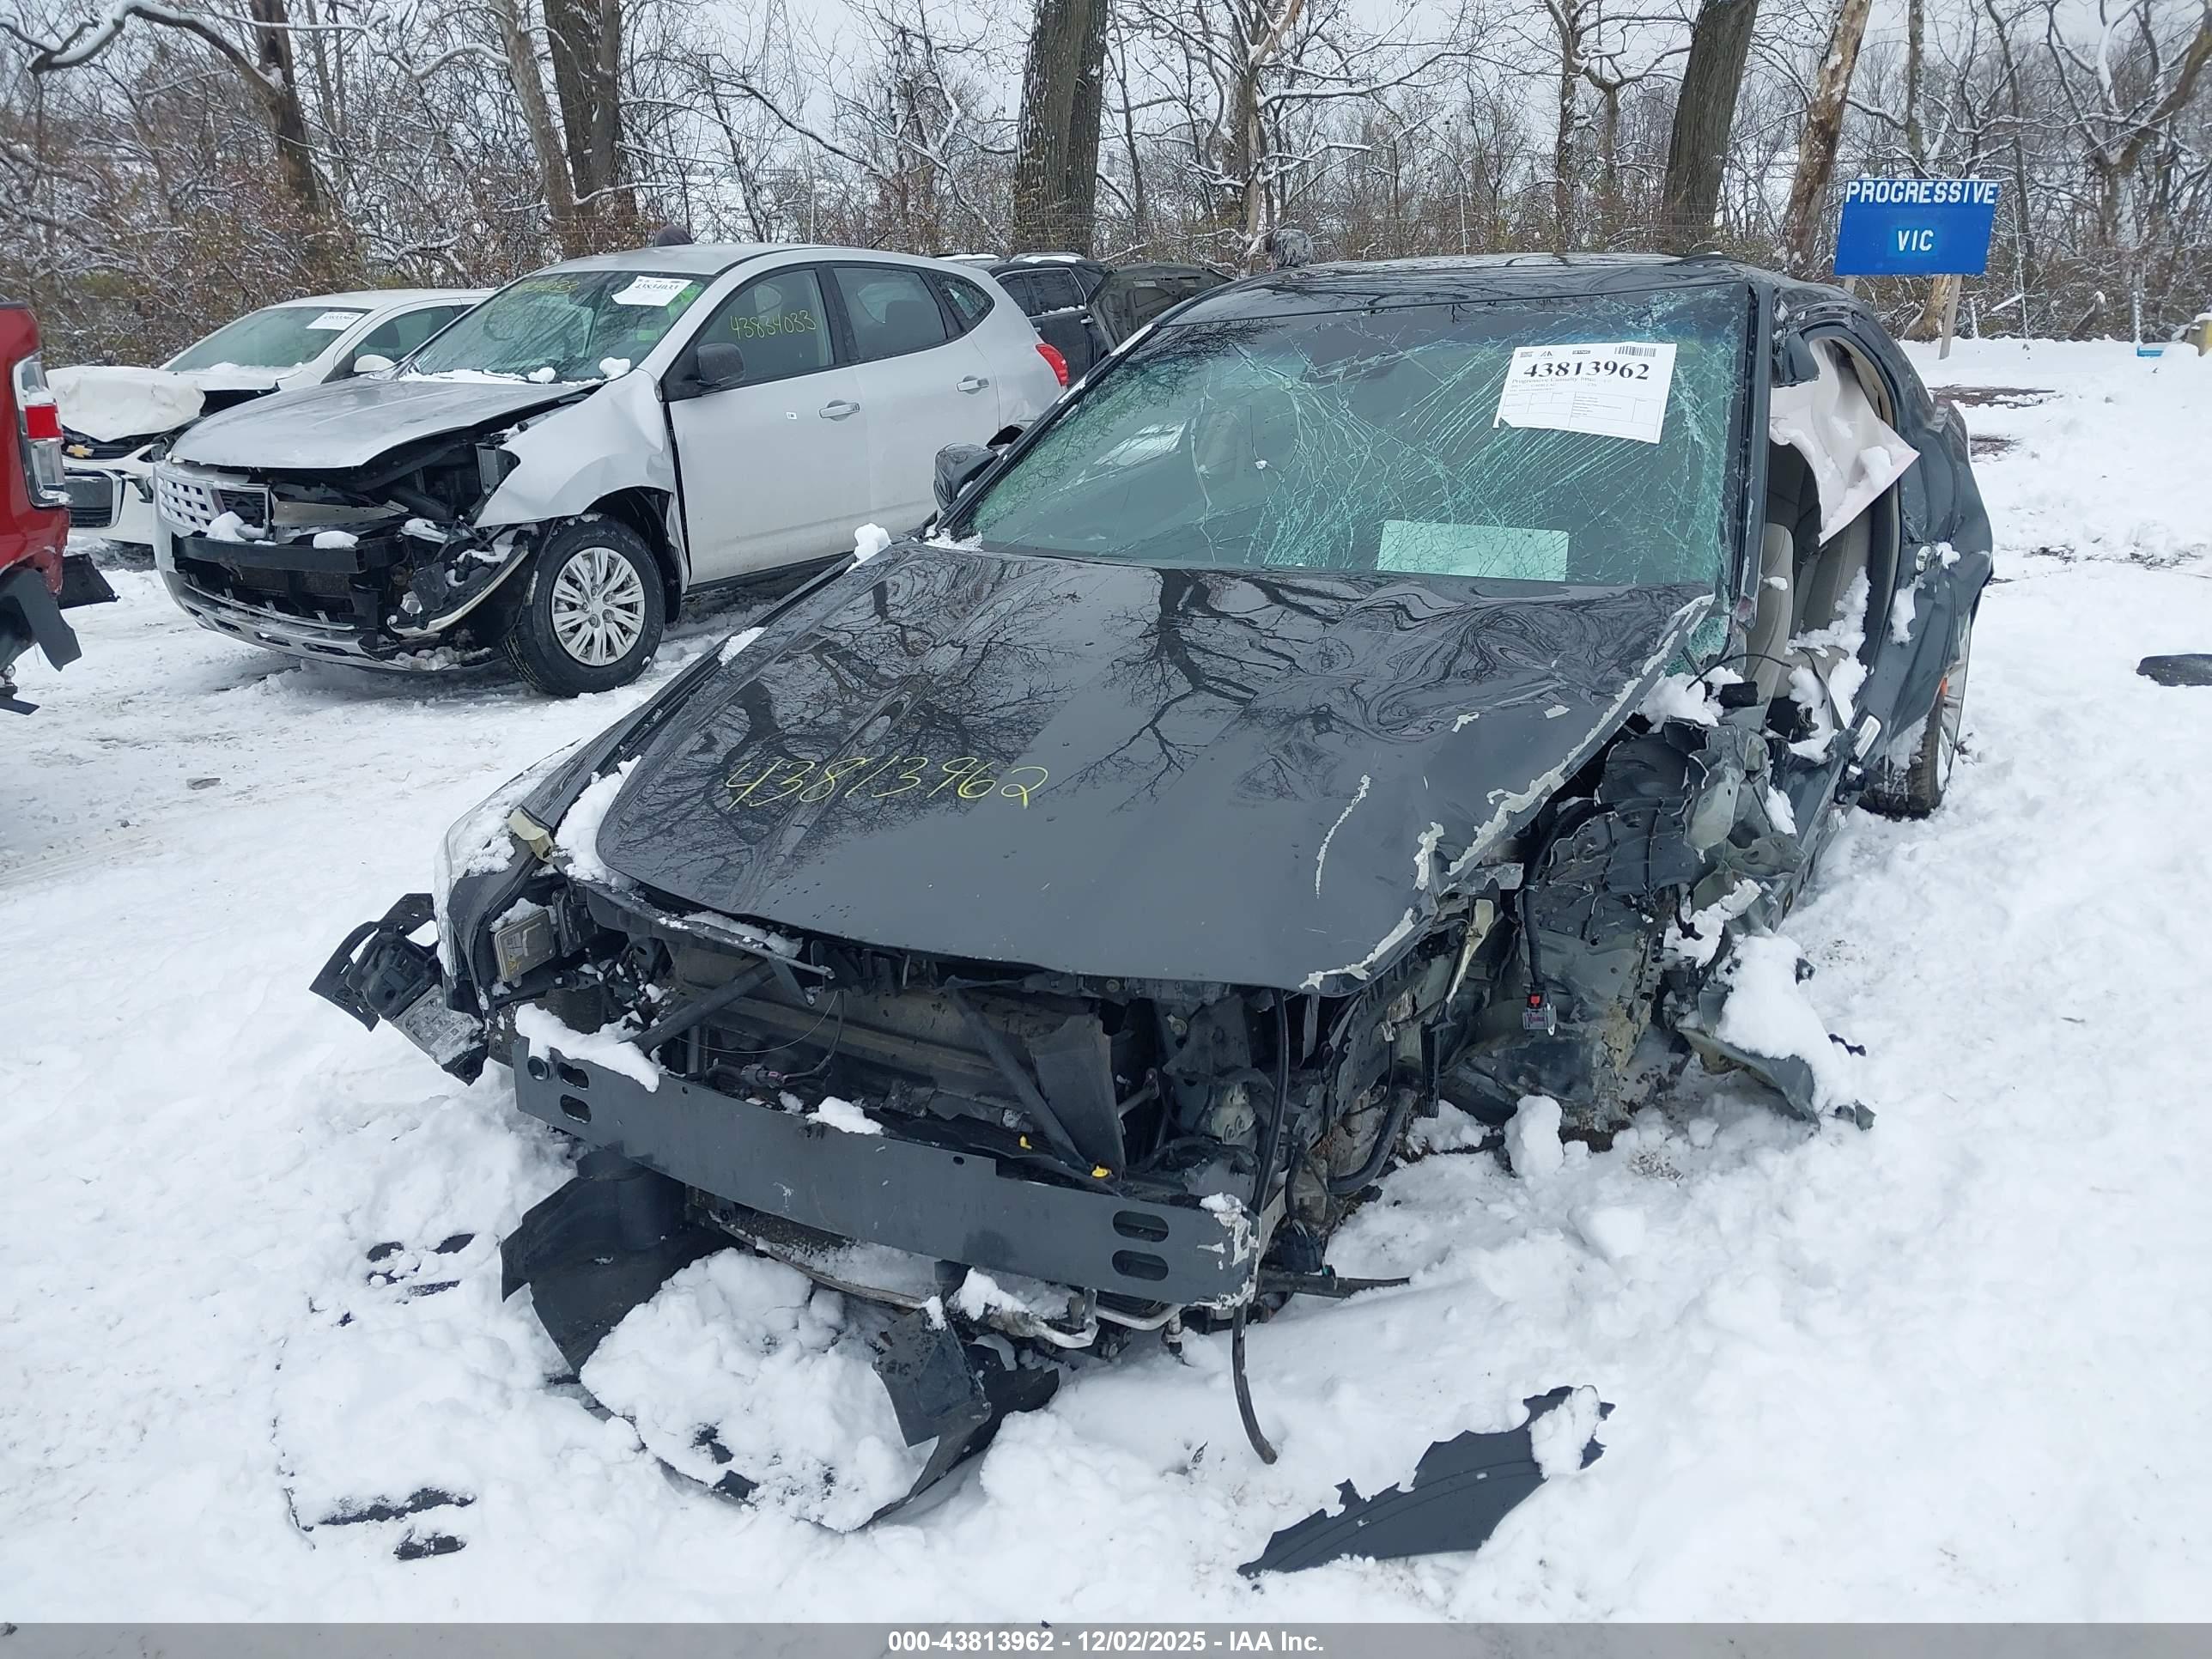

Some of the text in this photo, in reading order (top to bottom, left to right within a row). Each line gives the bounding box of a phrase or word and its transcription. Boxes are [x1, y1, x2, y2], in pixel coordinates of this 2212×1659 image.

[1845, 181, 1999, 204] PROGRESSIVE
[1898, 229, 1934, 252] VIC
[730, 310, 817, 340] 43834033
[1523, 361, 1650, 380] 43813962
[726, 756, 1049, 811] 43813962
